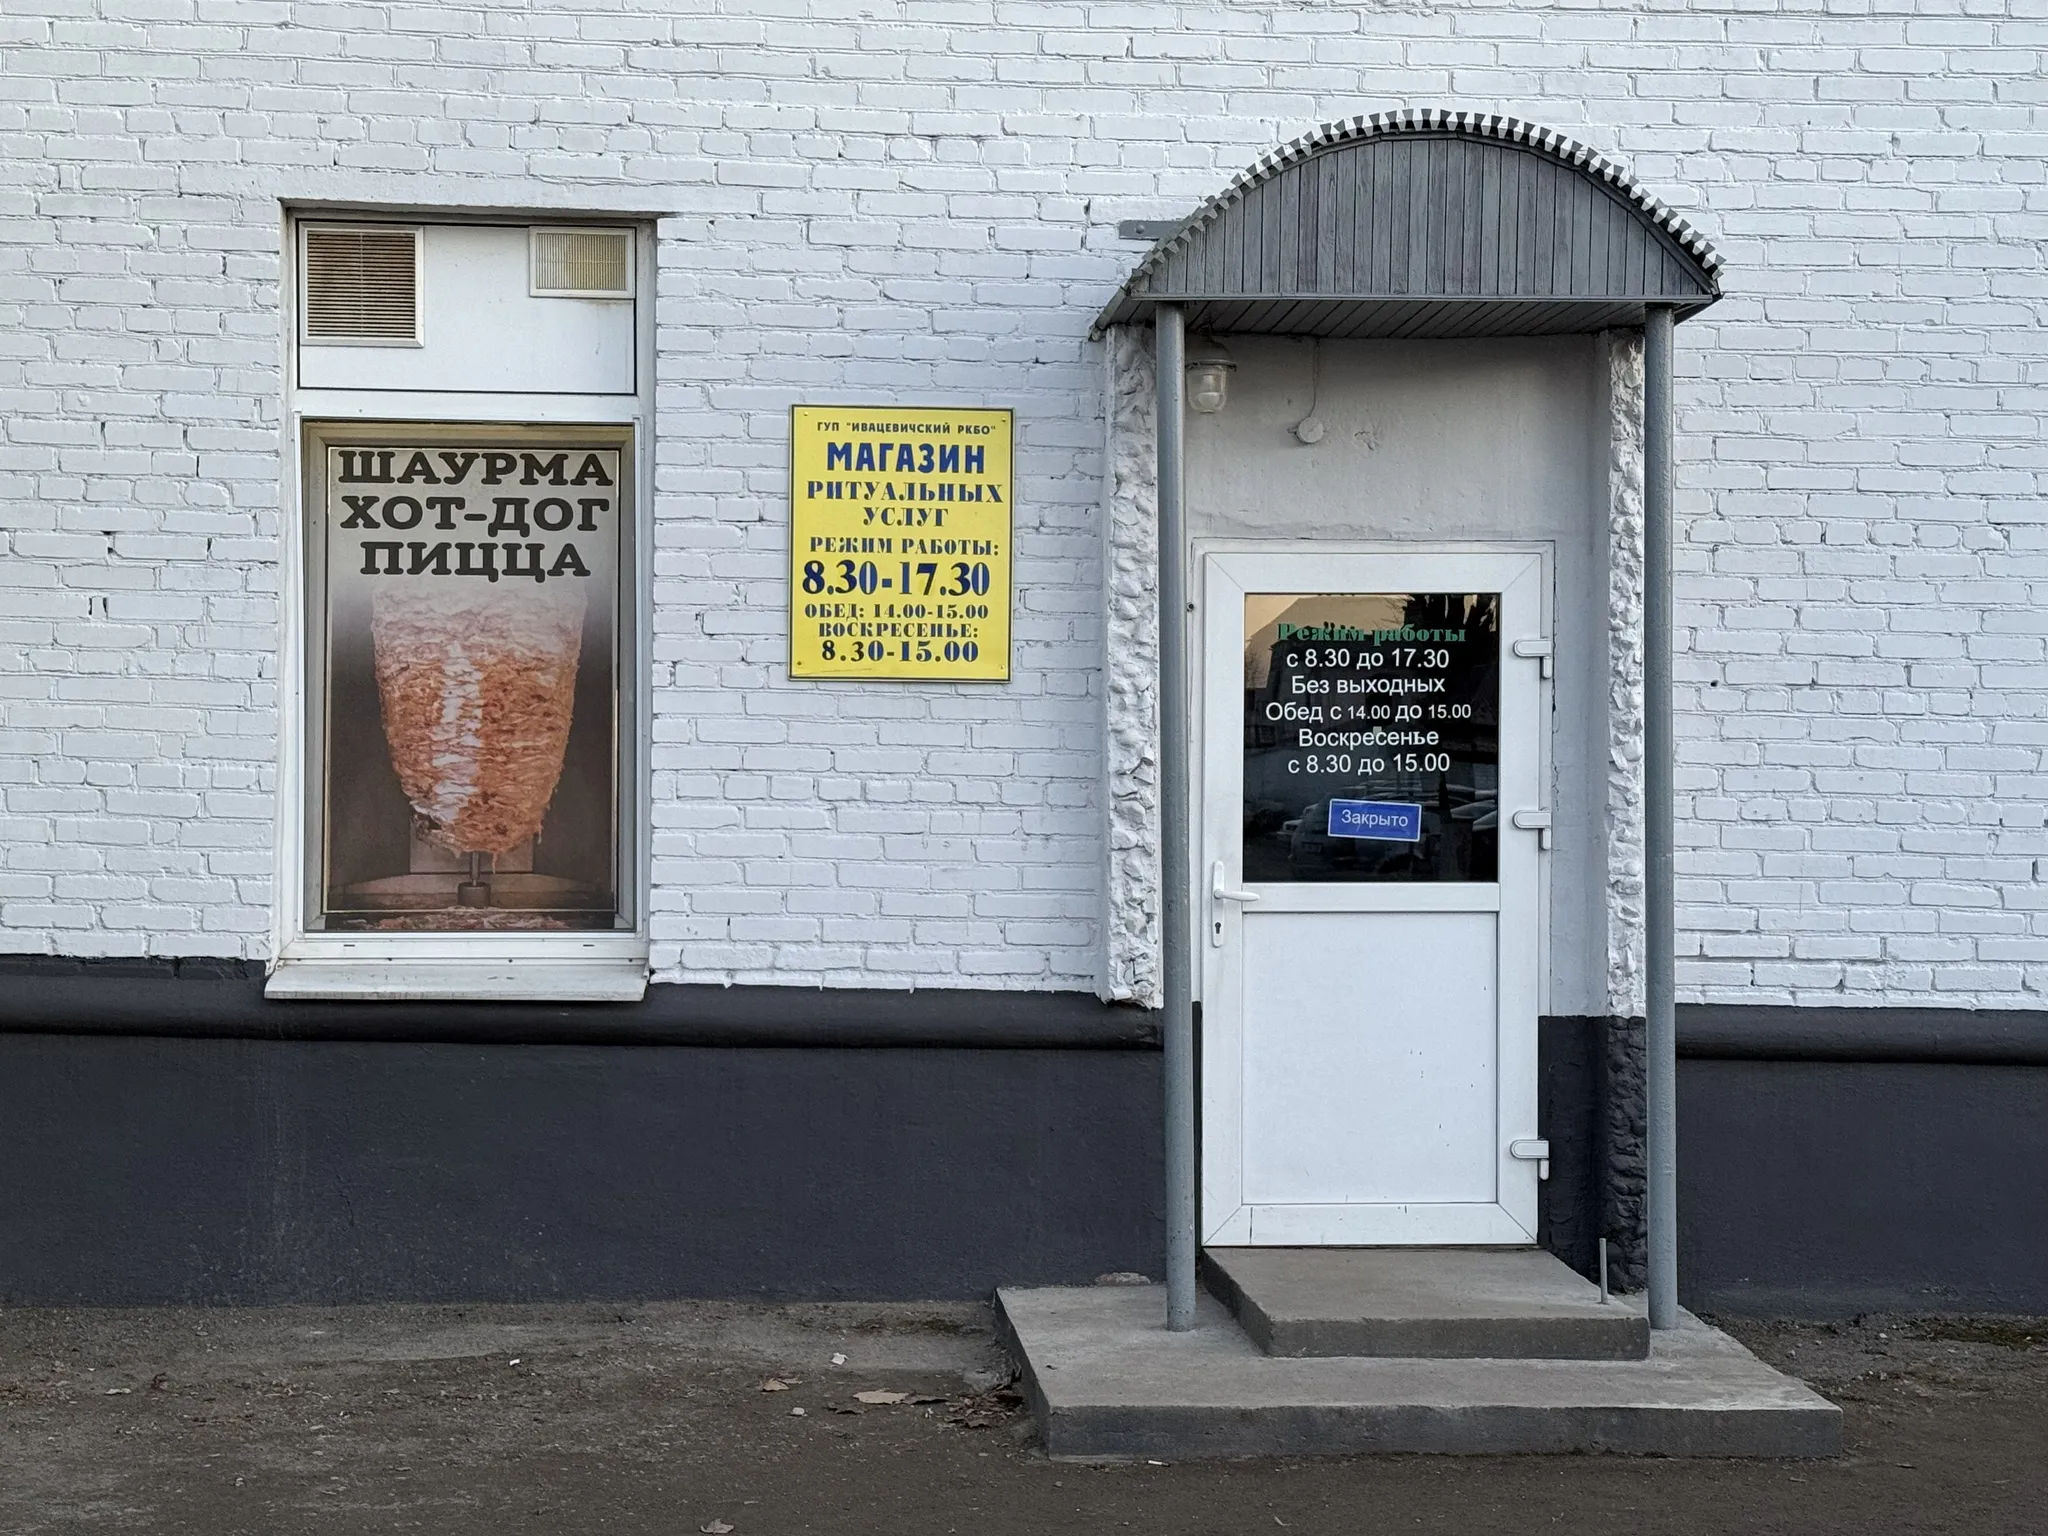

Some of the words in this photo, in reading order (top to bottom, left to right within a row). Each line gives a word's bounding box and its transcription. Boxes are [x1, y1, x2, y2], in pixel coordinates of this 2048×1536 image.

[817, 422, 839, 431] ГУП
[846, 422, 950, 434] "ИВАЦЕВИЧСКИЙ
[957, 425, 996, 435] РКБО"
[338, 451, 614, 486] ШАУРМА
[827, 442, 984, 474] МАГАЗИН
[807, 481, 1003, 503] РИТУАЛЬНЫХ
[340, 495, 610, 538] ХОТ-ДОГ
[863, 507, 948, 527] УСЛУГ
[810, 537, 893, 554] РЕЖИМ
[901, 538, 999, 556] РАБОТЫ:
[360, 542, 591, 583] ПИЦЦА
[802, 559, 990, 596] 8.30-17.30
[805, 603, 864, 621] ОБЕД:
[874, 604, 989, 619] 14.00-15.00
[819, 622, 978, 638] ВОСКРЕСЕНЬЕ:
[1278, 623, 1365, 641] Режим
[1372, 623, 1466, 646] работы
[821, 640, 979, 662] 8.30-15.00
[1286, 653, 1299, 668] с
[1304, 649, 1350, 668] 8.30
[1356, 653, 1384, 670] до
[1392, 649, 1450, 668] 17.30
[1292, 675, 1330, 694] Без
[1337, 678, 1446, 696] выходных
[1265, 702, 1323, 723] Обед
[1330, 705, 1342, 720] с
[1348, 705, 1391, 720] 14.00
[1395, 704, 1422, 722] до
[1428, 704, 1472, 719] 15.00
[1299, 728, 1439, 750] Воскресенье
[1287, 759, 1300, 774] с
[1306, 754, 1351, 774] 8.30
[1357, 757, 1385, 775] до
[1393, 753, 1450, 772] 15.00
[1341, 809, 1409, 828] Закрыто
